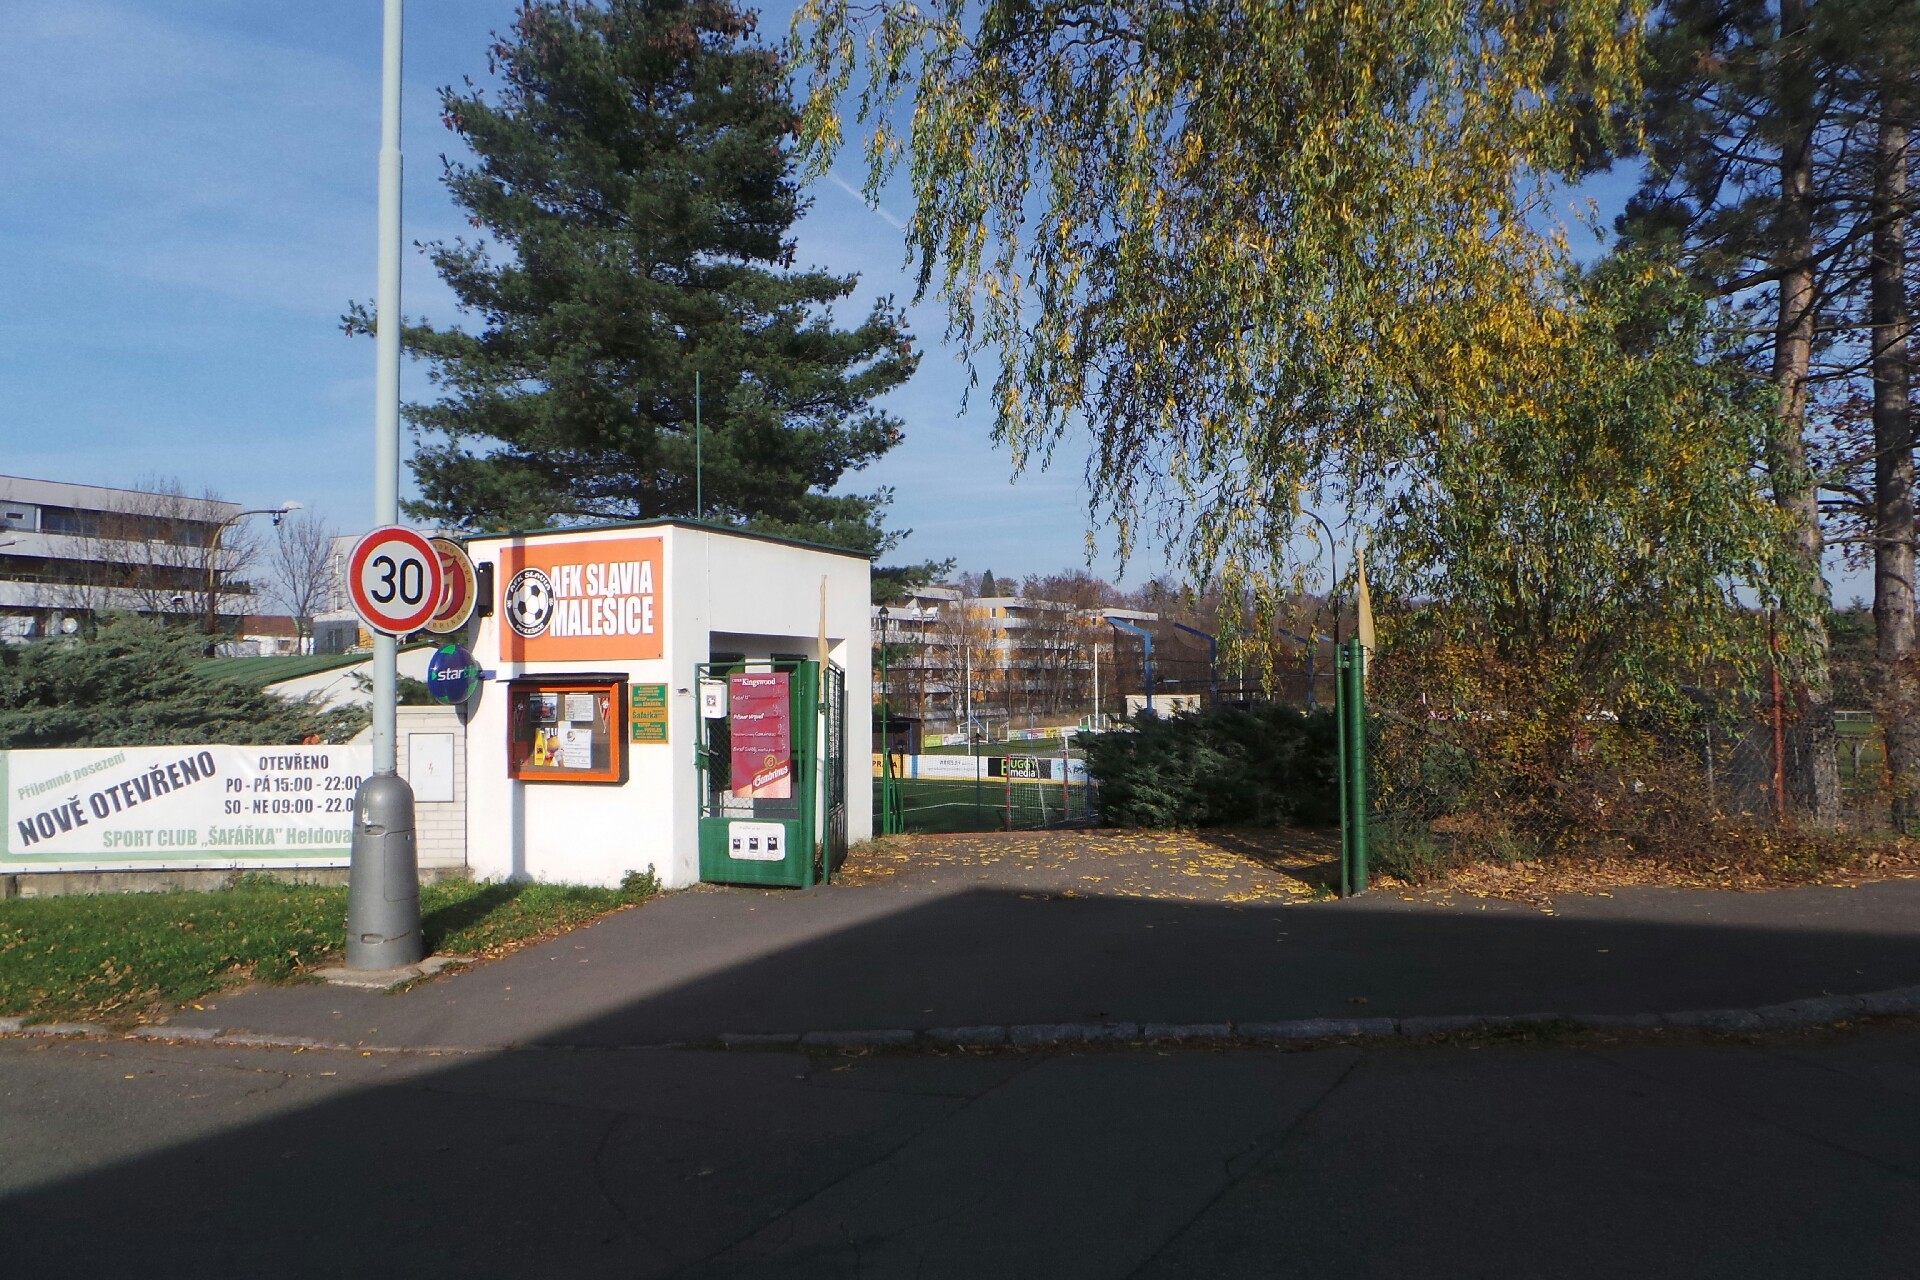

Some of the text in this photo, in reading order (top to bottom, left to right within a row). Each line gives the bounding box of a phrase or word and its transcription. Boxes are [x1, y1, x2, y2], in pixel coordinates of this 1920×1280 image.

[371, 555, 424, 605] 30
[524, 571, 551, 591] SLAVIA
[551, 560, 654, 597] AFK SLAVIA
[549, 588, 654, 637] MALEŠICE
[73, 750, 127, 781] posezení
[259, 753, 329, 771] OTEVŘENO
[872, 760, 898, 768] PRA
[753, 765, 788, 787] Gambrinus
[1010, 768, 1036, 778] media
[226, 778, 242, 793] PO
[253, 775, 271, 793] PÁ
[273, 777, 313, 793] 15:00
[324, 775, 362, 791] 22:00
[17, 750, 217, 847] NOVĚ OTEVŘENO
[224, 800, 241, 815] SO
[252, 799, 269, 815] NE
[272, 798, 314, 814] 09:00
[325, 797, 354, 813] 22.0
[102, 830, 153, 848] SPORT
[157, 829, 197, 846] CLUB
